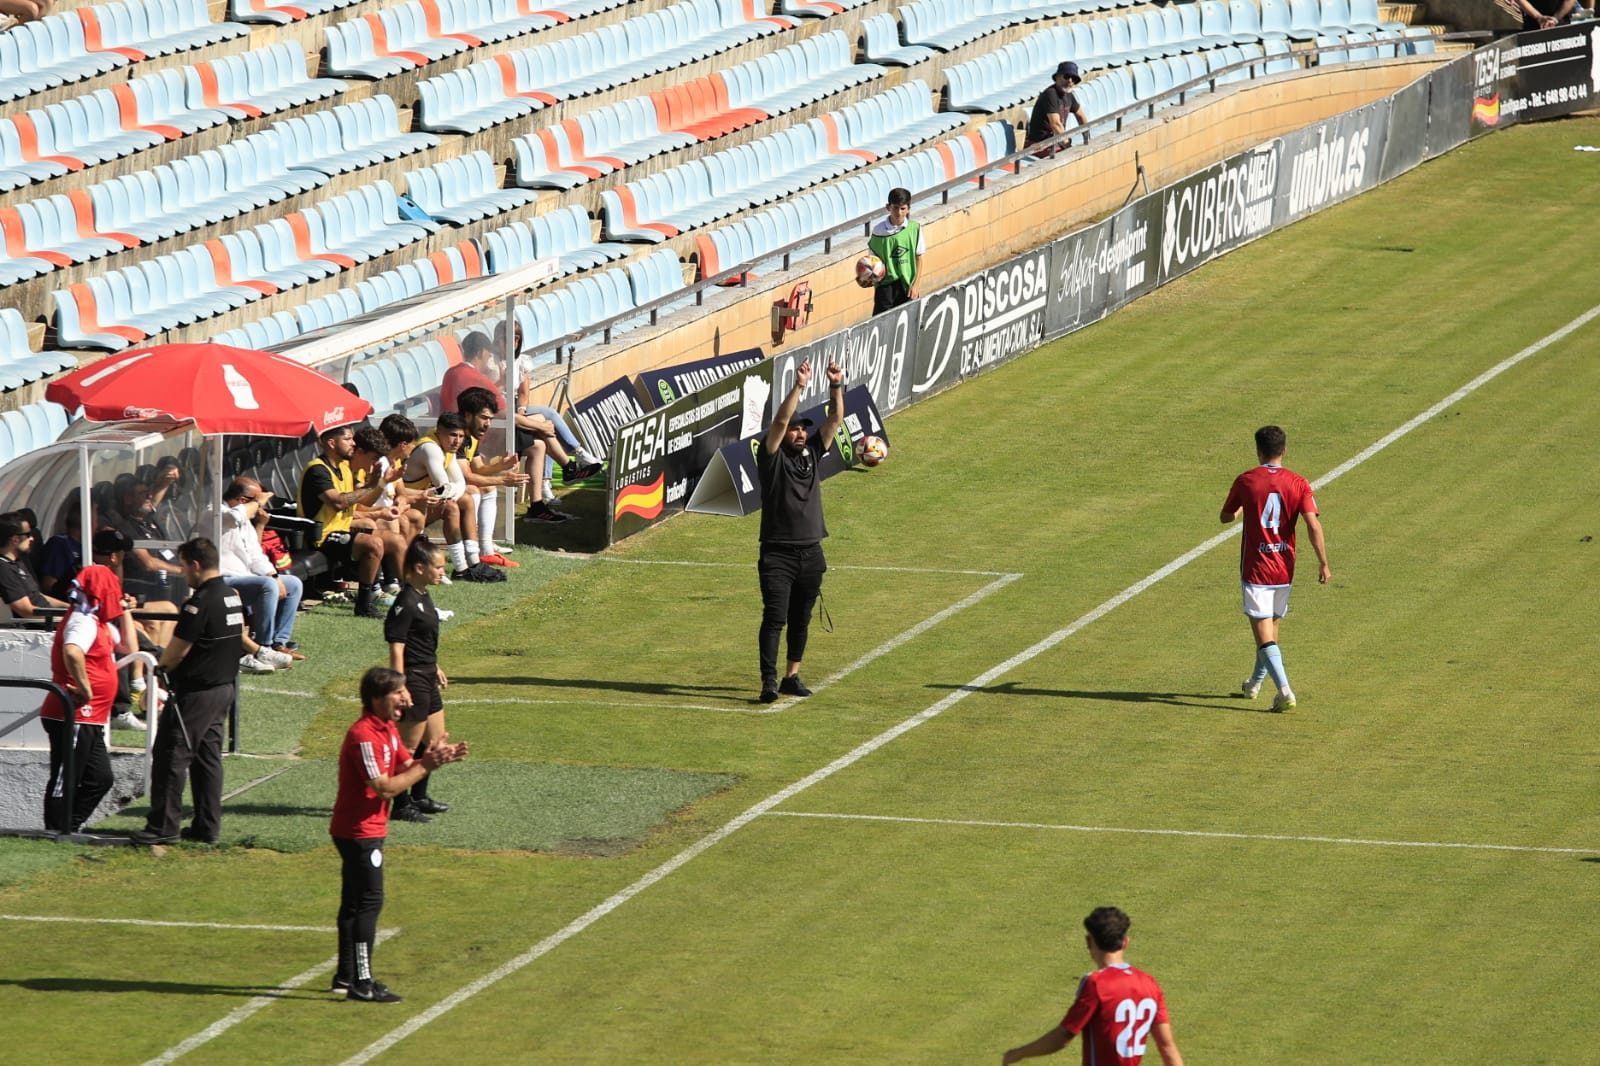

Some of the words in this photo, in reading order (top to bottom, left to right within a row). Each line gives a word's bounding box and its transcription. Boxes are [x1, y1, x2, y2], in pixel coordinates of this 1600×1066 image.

[1474, 47, 1500, 88] TGSA
[1246, 148, 1277, 203] HIELO
[1175, 163, 1248, 265] CUBERS
[963, 254, 1047, 327] DISCOSA
[960, 344, 972, 375] DE
[620, 412, 667, 475] TGSA
[615, 466, 652, 491] LOGISTICS
[1260, 492, 1282, 535] 4
[1114, 997, 1158, 1058] 22
